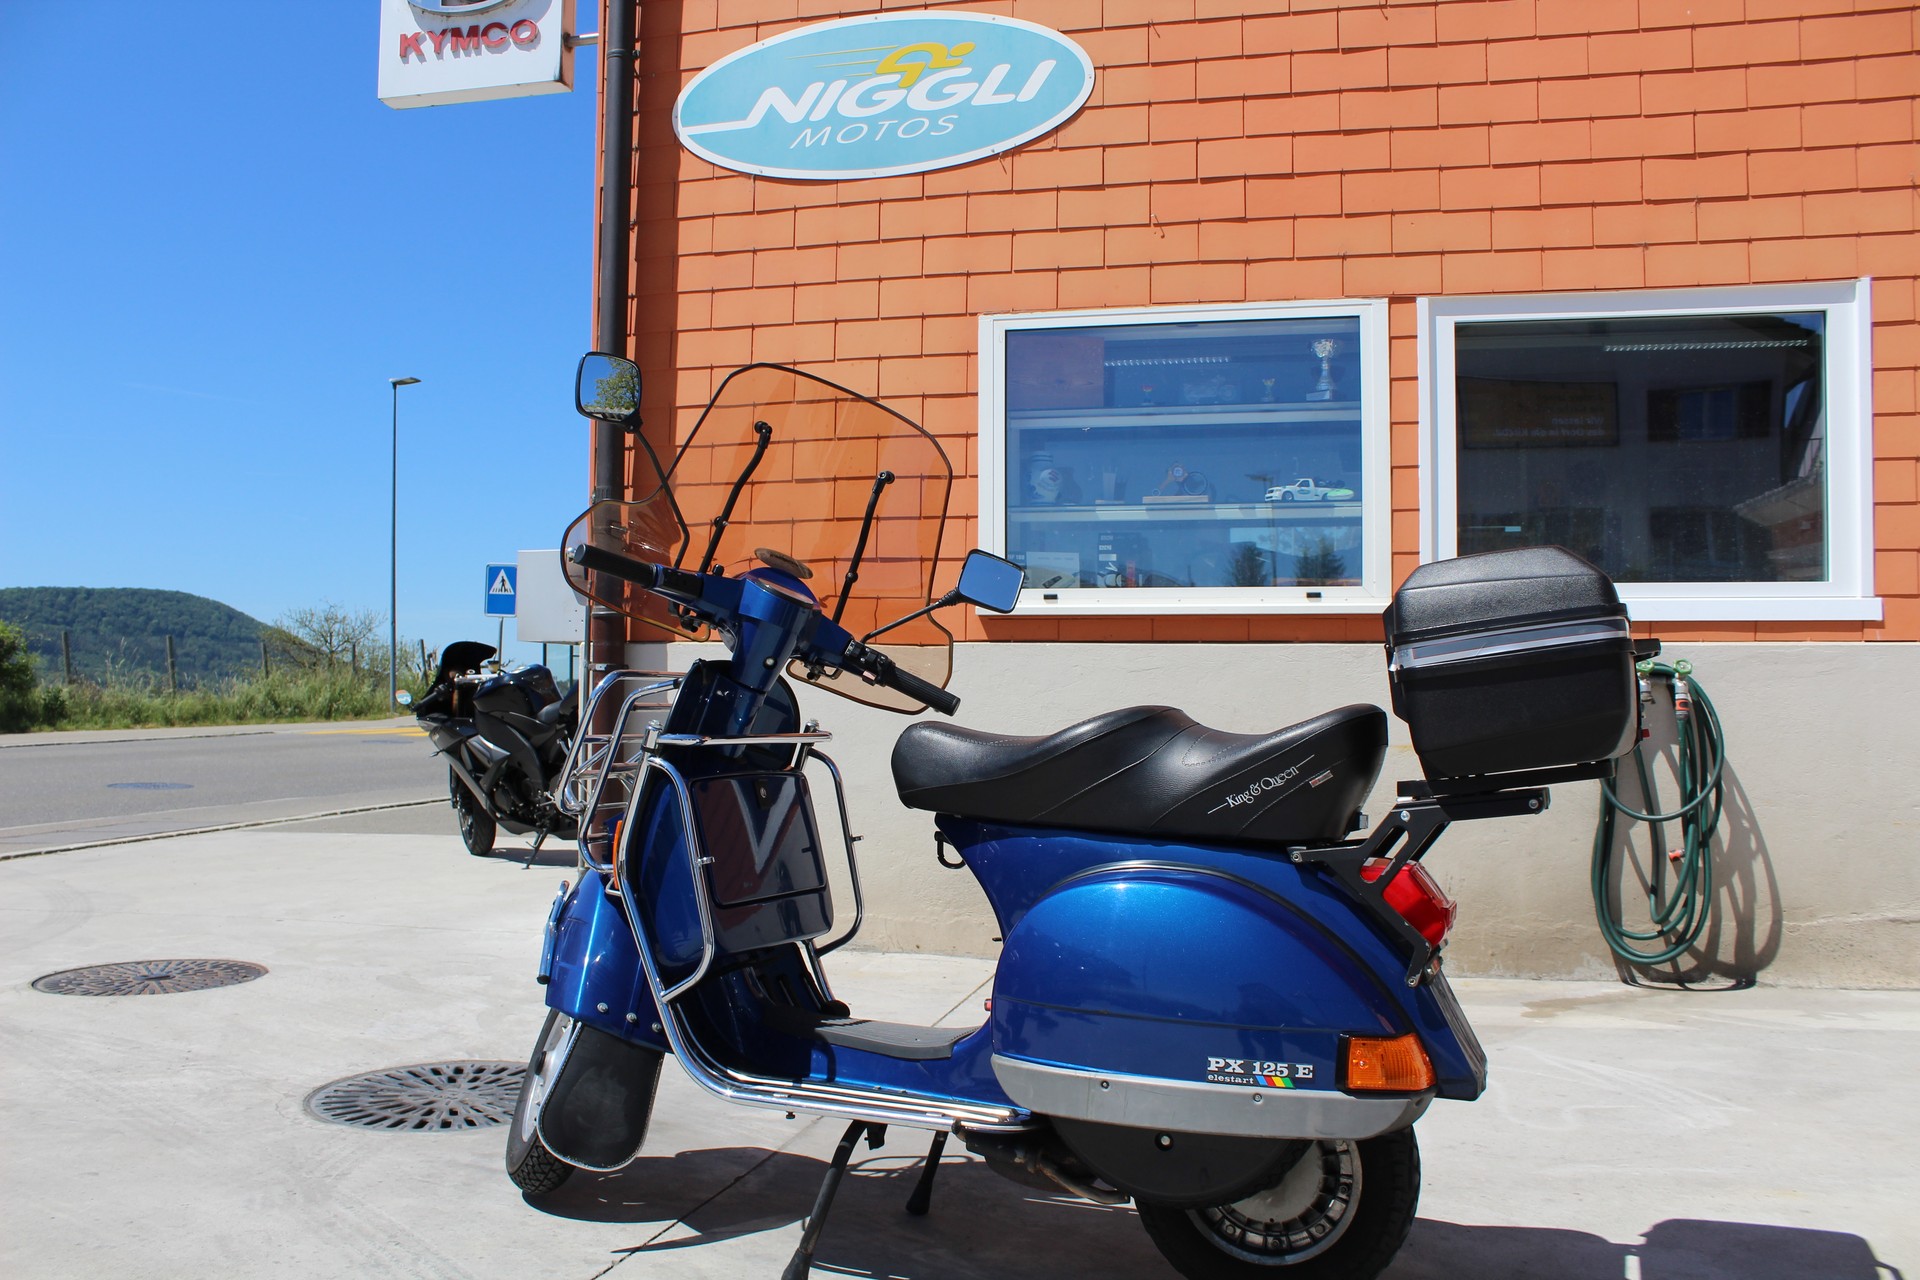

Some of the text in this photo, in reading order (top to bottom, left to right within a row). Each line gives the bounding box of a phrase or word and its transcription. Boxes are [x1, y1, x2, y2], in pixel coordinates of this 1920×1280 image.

[400, 19, 538, 58] KYMCO
[738, 59, 1057, 129] NIGGLI
[790, 114, 959, 150] MOTOS
[1225, 789, 1254, 808] King
[1250, 782, 1262, 796] &
[1260, 766, 1299, 790] Queen
[1207, 1056, 1314, 1078] PX 125 E
[1207, 1073, 1255, 1085] elestart
